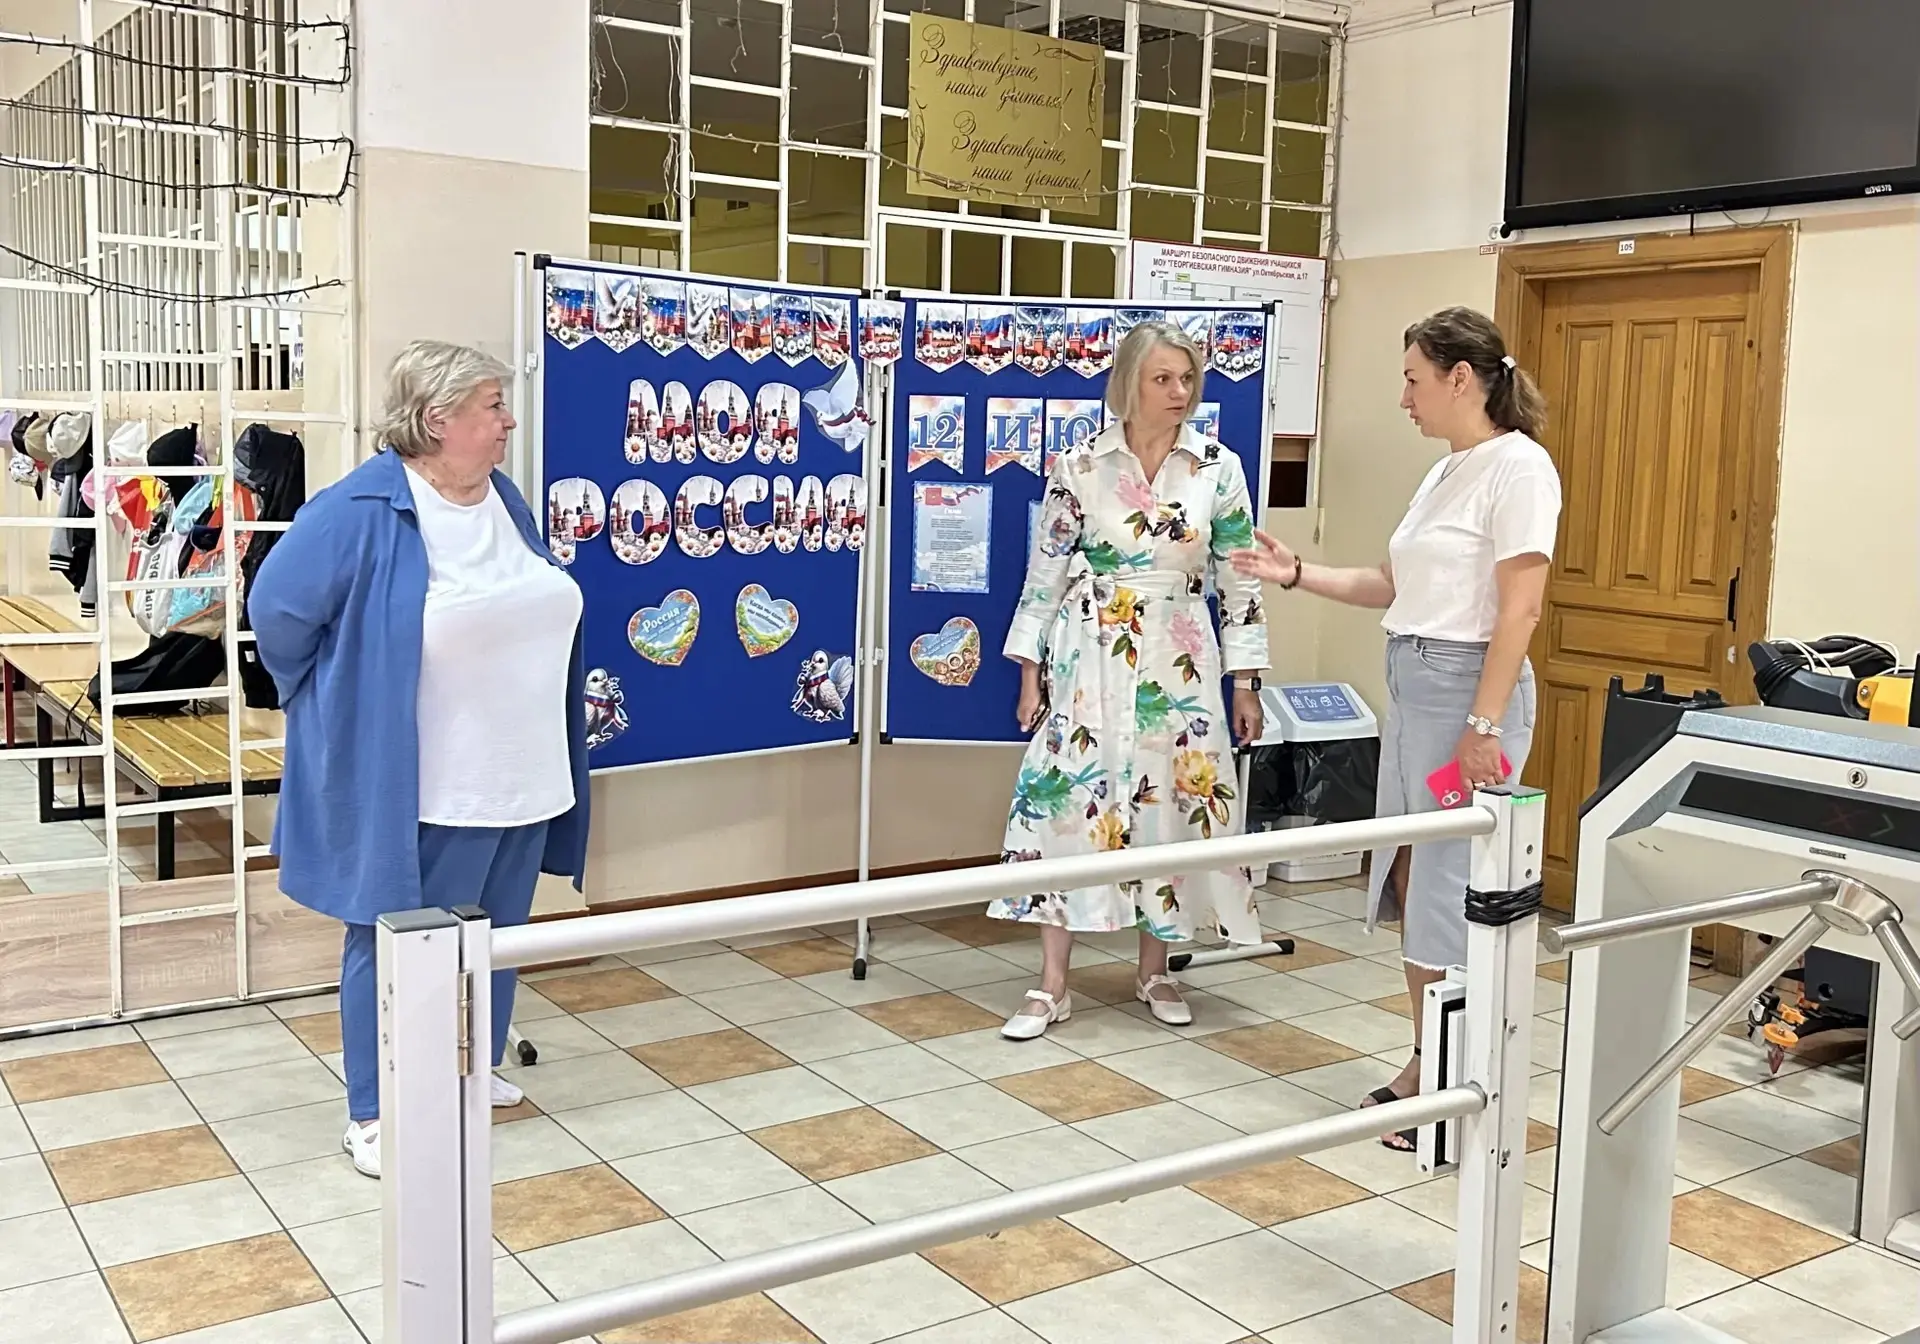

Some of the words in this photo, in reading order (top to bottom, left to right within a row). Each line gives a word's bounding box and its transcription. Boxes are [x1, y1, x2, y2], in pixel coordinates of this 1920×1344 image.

[920, 23, 1039, 85] Здравствуйте,
[945, 80, 988, 98] наши
[996, 88, 1073, 111] учителя!
[952, 110, 1067, 169] Здравствуйте,
[972, 165, 1013, 182] наши
[1025, 169, 1091, 192] ученики!
[1161, 248, 1191, 258] МАРШРУТ
[1192, 251, 1237, 263] БЕЗОПАСНОГО
[1237, 256, 1269, 266] ДВИЖЕНИЯ
[1270, 260, 1302, 269] УЧАЩИХСЯ
[1620, 243, 1633, 251] 105
[1153, 258, 1166, 267] МОУ
[1168, 260, 1217, 271] "ГЕОРГИЕВСКАЯ
[1217, 265, 1252, 274] ГИМНАЗИЯ"
[623, 379, 801, 465] МОЯ
[911, 412, 961, 451] 12
[548, 474, 868, 566] РОССИЯ
[641, 607, 681, 633] Россия
